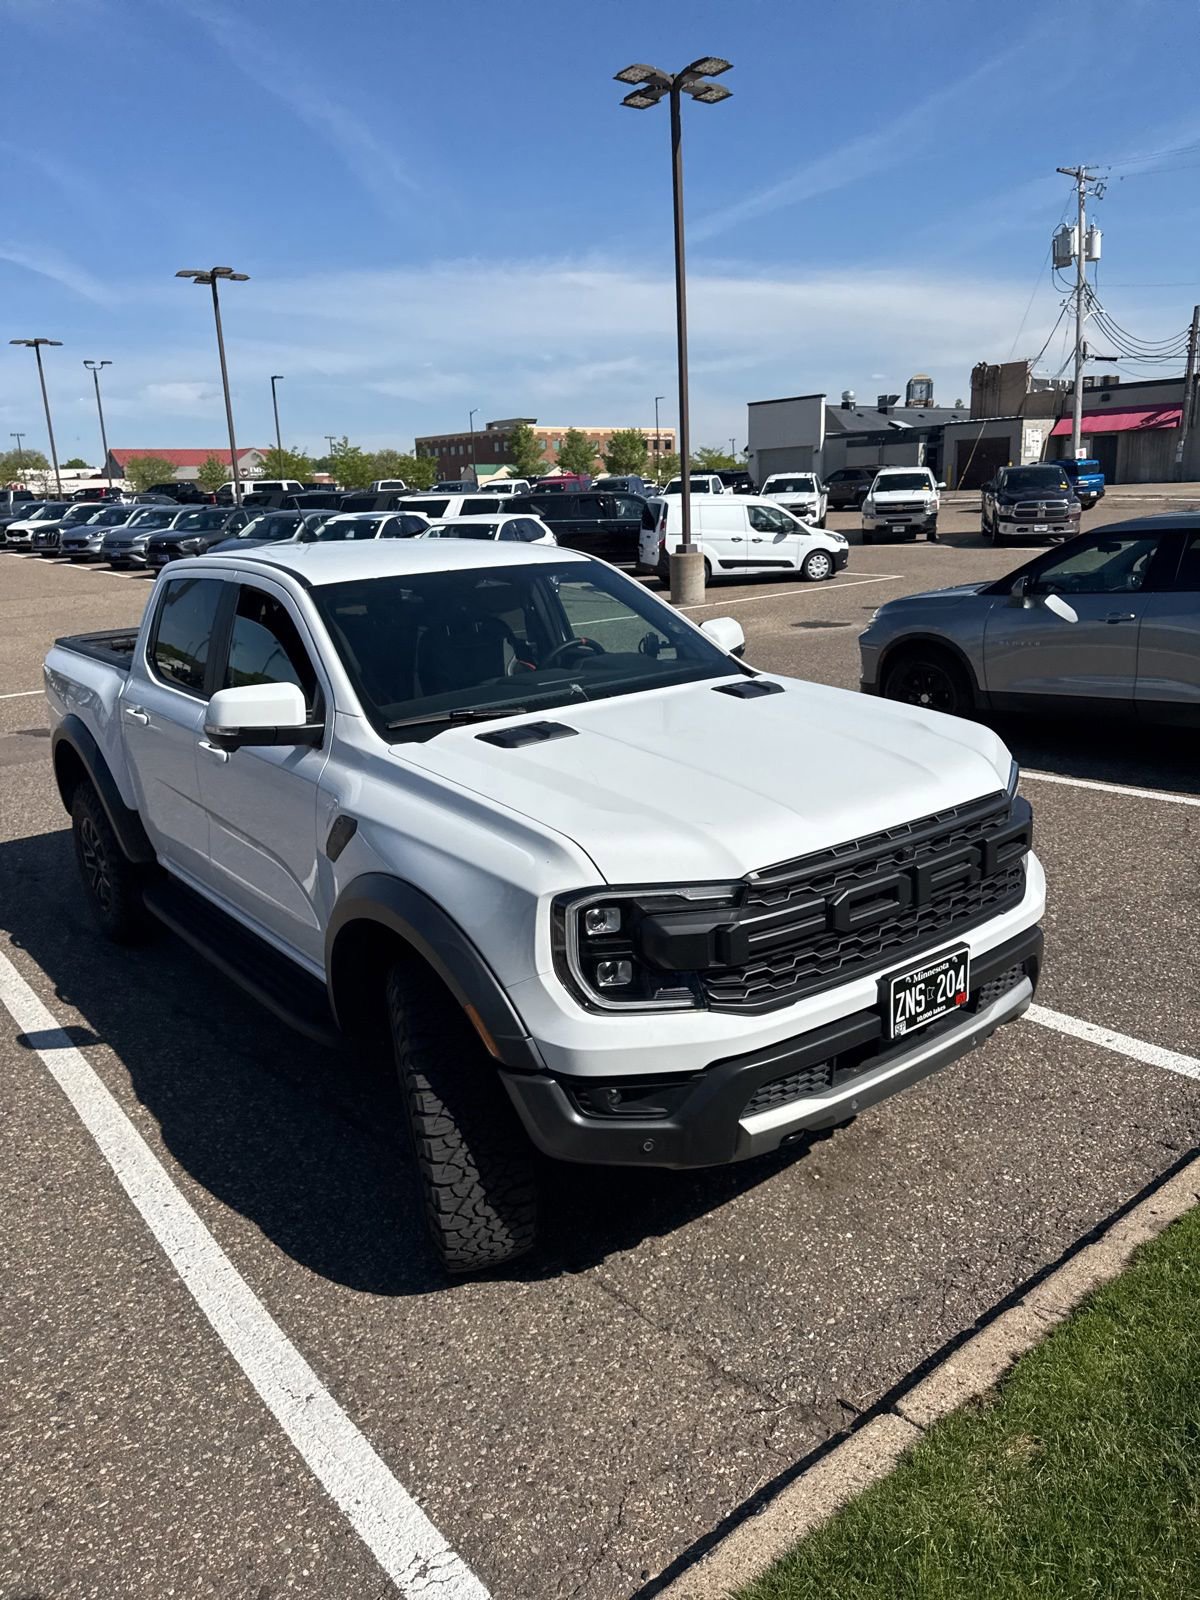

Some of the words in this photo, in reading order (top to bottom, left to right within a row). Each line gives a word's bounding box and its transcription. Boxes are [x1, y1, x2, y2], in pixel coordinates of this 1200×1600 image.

[712, 808, 1032, 967] FORD
[895, 983, 925, 1023] ZNS
[937, 965, 965, 1004] 204
[913, 963, 949, 983] Minnesota
